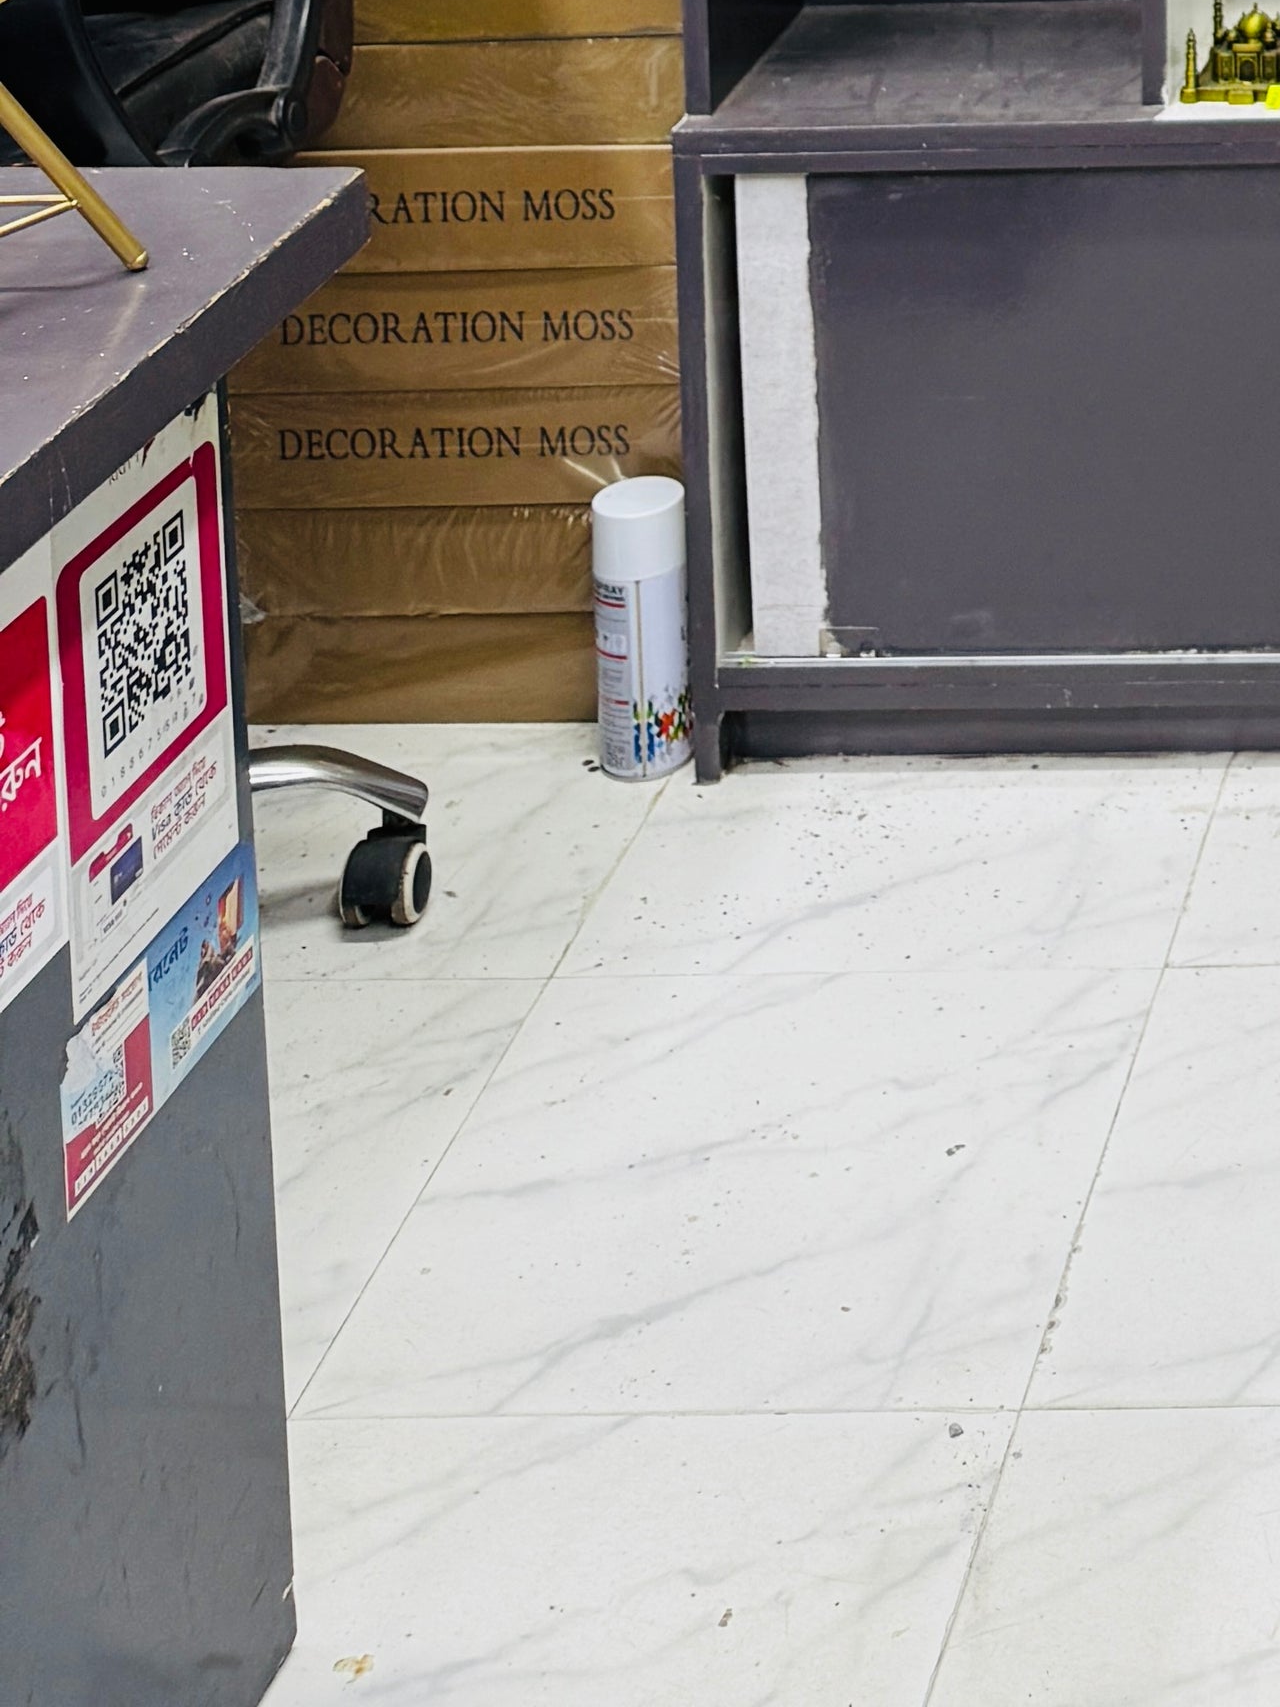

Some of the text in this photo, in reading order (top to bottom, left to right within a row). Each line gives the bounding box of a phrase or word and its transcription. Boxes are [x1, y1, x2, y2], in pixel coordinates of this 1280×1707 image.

[523, 188, 617, 222] MOSS
[280, 309, 635, 347] DECORATION MOSS
[278, 424, 631, 461] DECORATION MOSS
